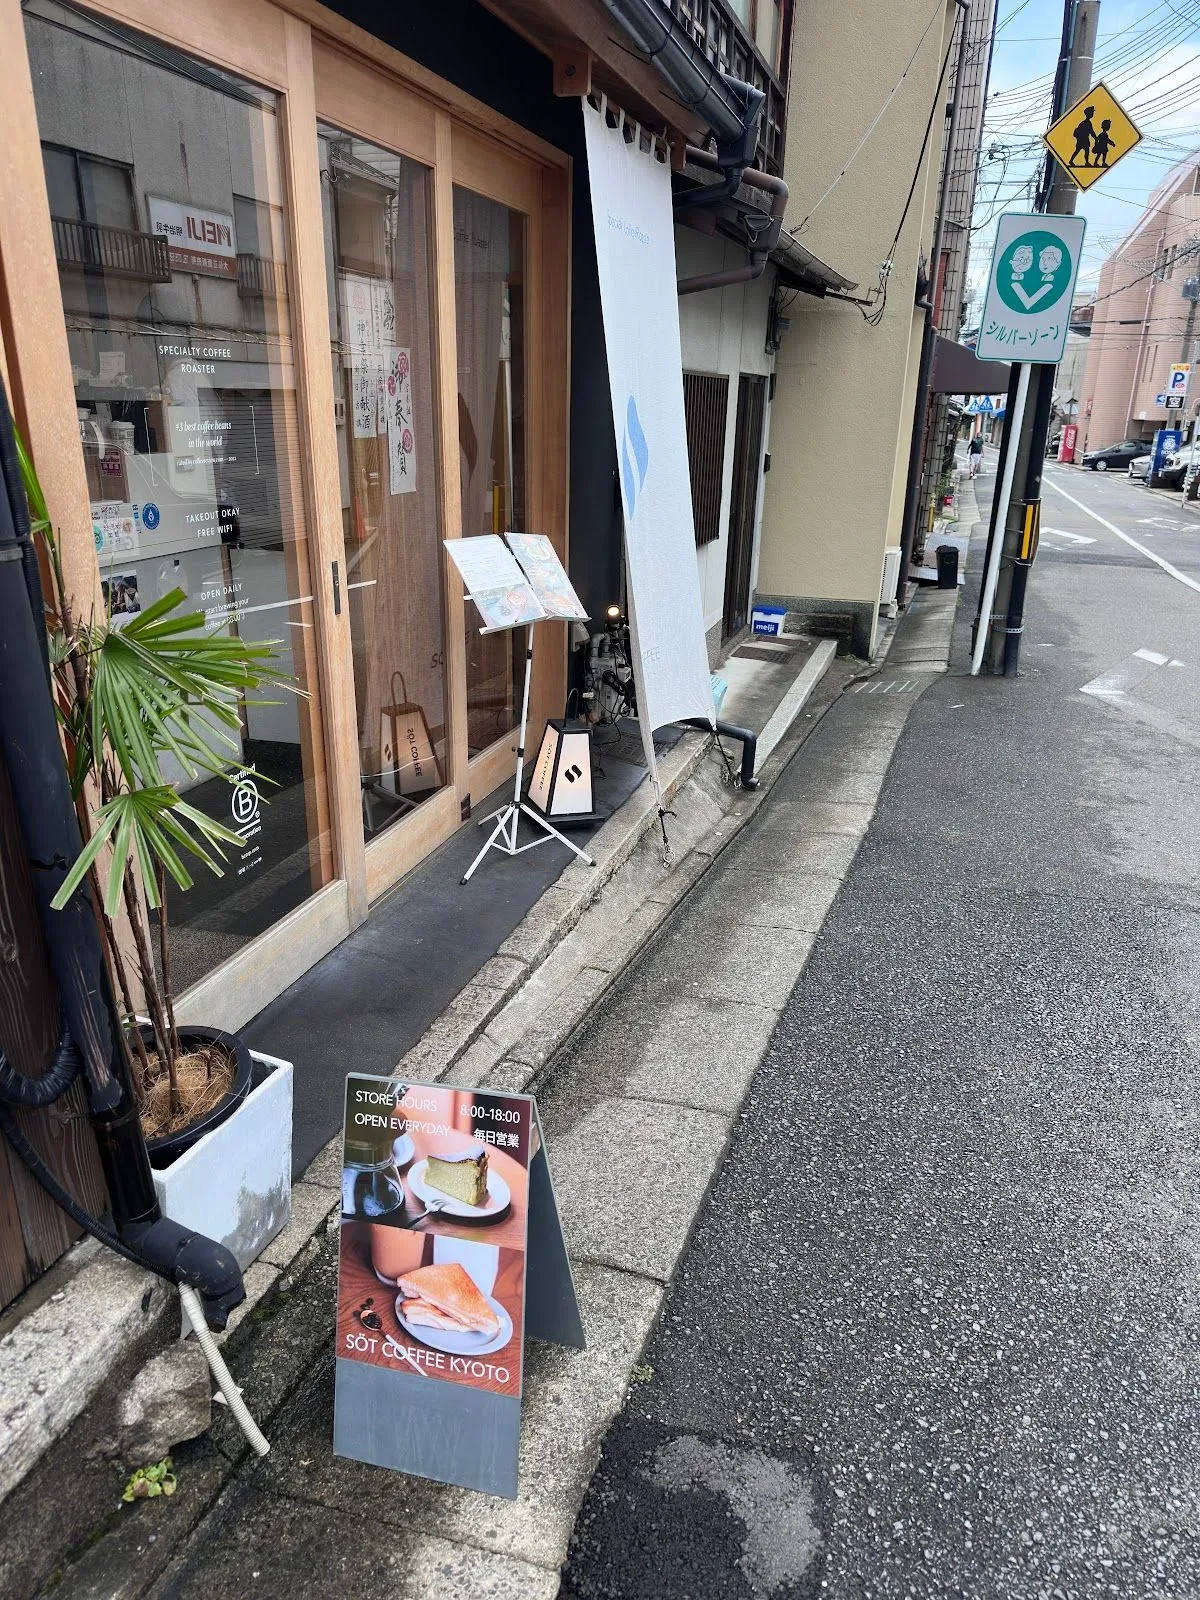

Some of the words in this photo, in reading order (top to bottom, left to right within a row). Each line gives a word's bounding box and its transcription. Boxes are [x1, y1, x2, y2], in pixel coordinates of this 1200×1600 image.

[985, 321, 1059, 346] シルバーゾーン
[158, 345, 201, 356] SPECIALTY
[203, 347, 232, 358] COFFEE
[181, 363, 215, 373] ROASTER
[1171, 372, 1185, 389] P
[185, 421, 198, 431] best
[198, 419, 214, 433] coffee
[214, 419, 232, 430] beans
[205, 435, 222, 447] world
[185, 510, 219, 523] TAKEOUT
[221, 507, 240, 518] OKAY
[197, 528, 215, 538] FREE
[217, 523, 233, 534] WIFI
[200, 590, 220, 601] OPEN
[223, 583, 242, 595] DAILY
[755, 623, 775, 633] meiji
[355, 1090, 393, 1106] STORE
[396, 1095, 438, 1112] HOURS
[460, 1104, 521, 1124] 8:00-18:00
[354, 1112, 388, 1128] OPEN
[390, 1118, 451, 1137] EVERYDAY
[473, 1128, 520, 1148] 毎日営業
[345, 1333, 378, 1354] SÖT
[381, 1341, 445, 1369] COFFEE
[450, 1355, 510, 1384] KYOTO
